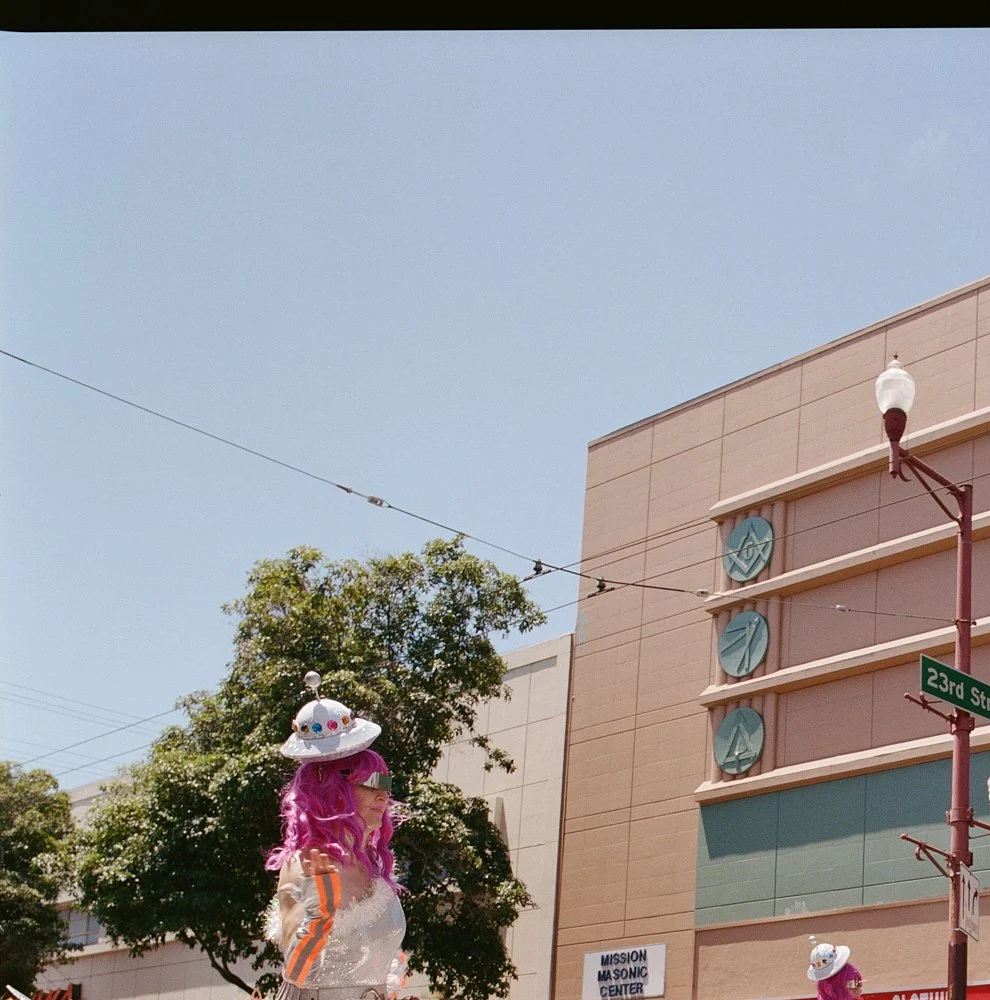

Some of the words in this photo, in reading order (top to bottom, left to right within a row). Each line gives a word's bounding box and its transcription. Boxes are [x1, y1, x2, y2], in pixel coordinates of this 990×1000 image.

[927, 667, 964, 700] 23rd
[601, 949, 647, 966] MISSION
[597, 966, 648, 982] MASONIC
[600, 982, 644, 998] CENTER
